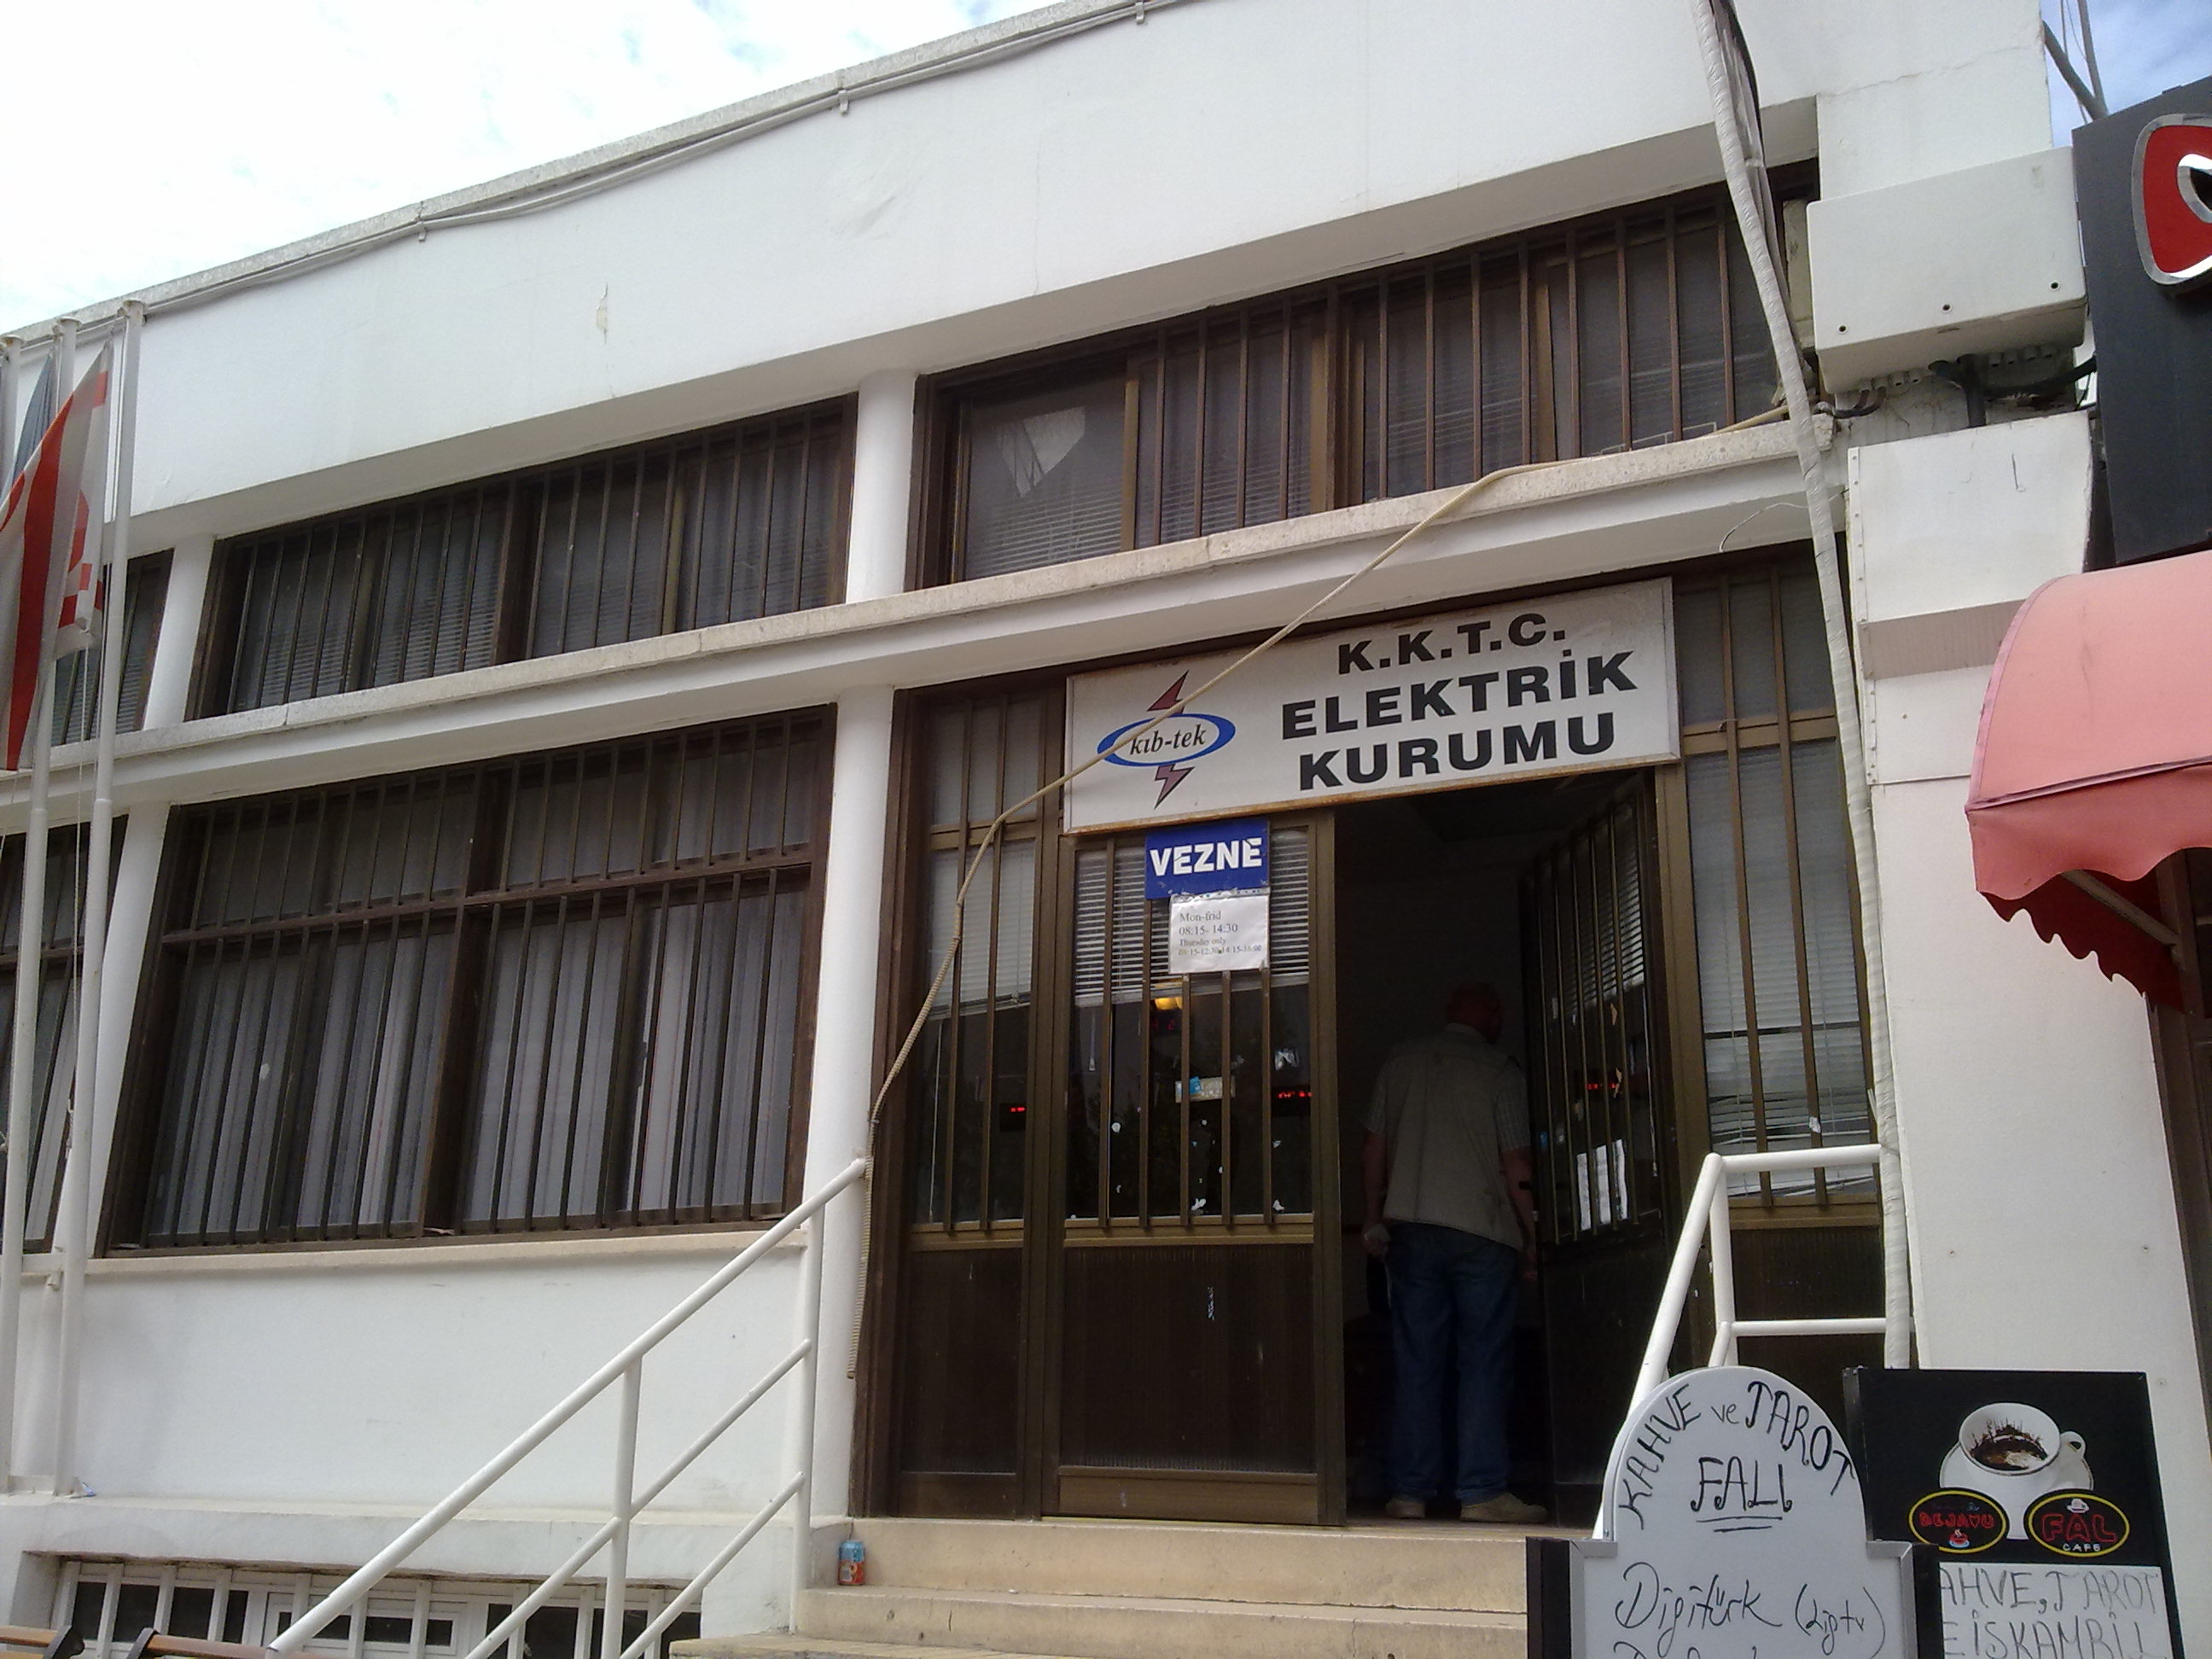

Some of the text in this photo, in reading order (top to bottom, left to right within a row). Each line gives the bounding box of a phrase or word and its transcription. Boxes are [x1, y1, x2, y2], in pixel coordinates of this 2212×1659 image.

[1338, 613, 1566, 674] K.K.T.C.
[1282, 649, 1639, 741] ELEKTRİK
[1299, 712, 1615, 792] KURUMU
[1150, 837, 1262, 876] VEZNE
[1179, 911, 1222, 923] Mon-frid
[1619, 1380, 1856, 1530] KAHVE ve TAROT
[2040, 1513, 2117, 1543] FAL
[2062, 1542, 2102, 1552] CAFE
[1940, 1567, 2047, 1615] AHVE,
